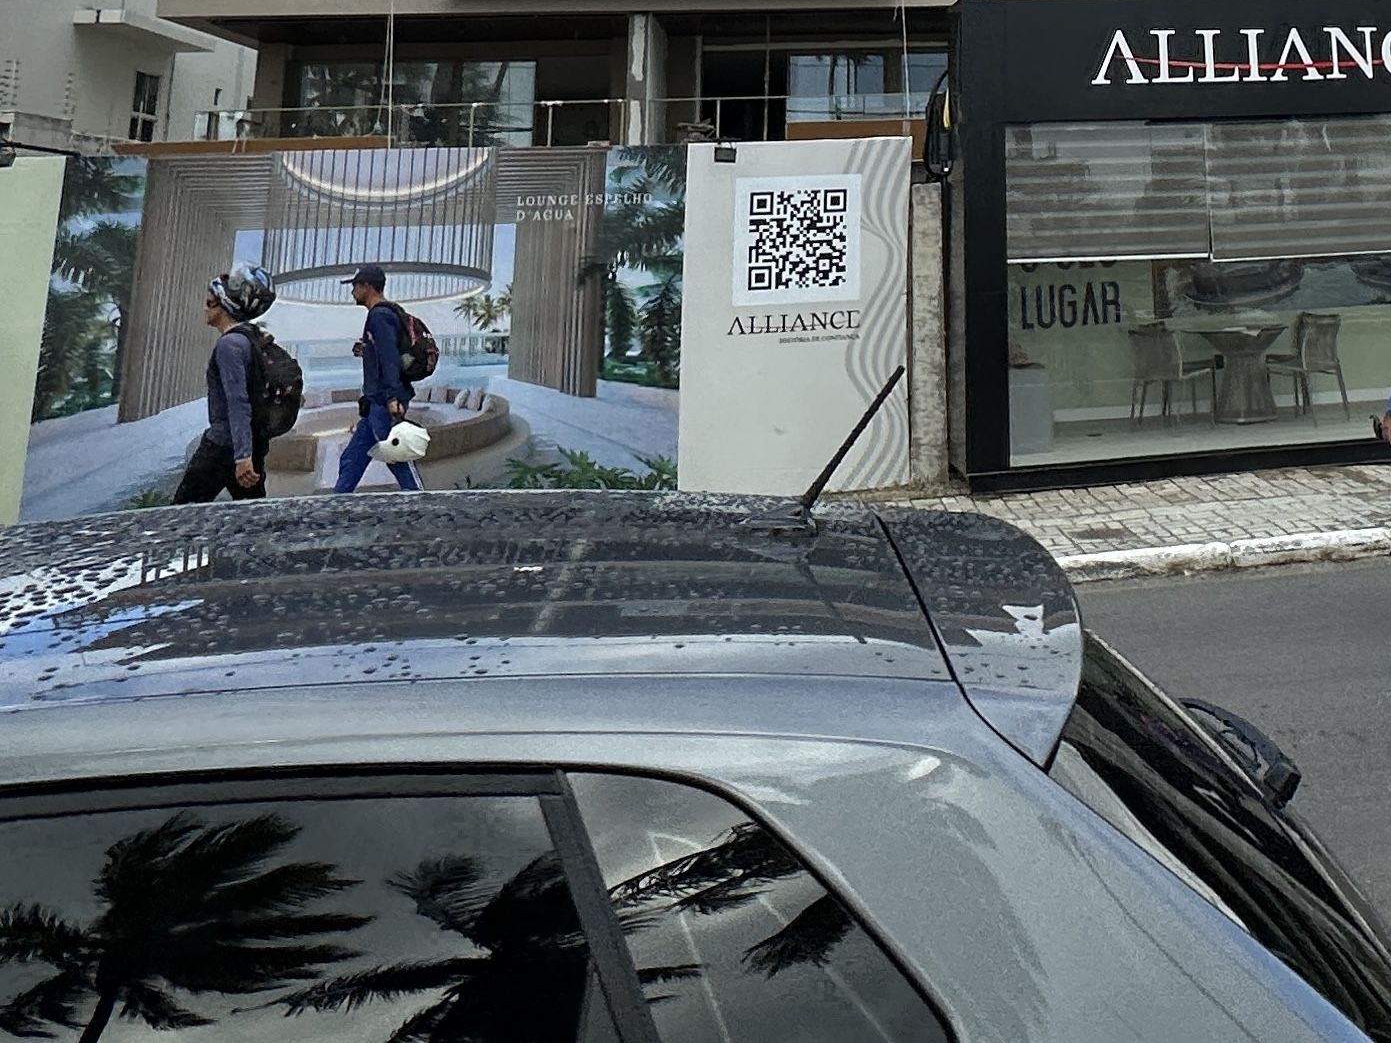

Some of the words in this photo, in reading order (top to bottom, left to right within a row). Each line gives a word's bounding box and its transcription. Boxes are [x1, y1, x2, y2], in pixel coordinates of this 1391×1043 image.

[517, 195, 578, 207] LOUNGE
[585, 193, 652, 205] ESPELHO
[1021, 281, 1121, 330] LUGAR
[727, 310, 861, 335] ALLIANCE
